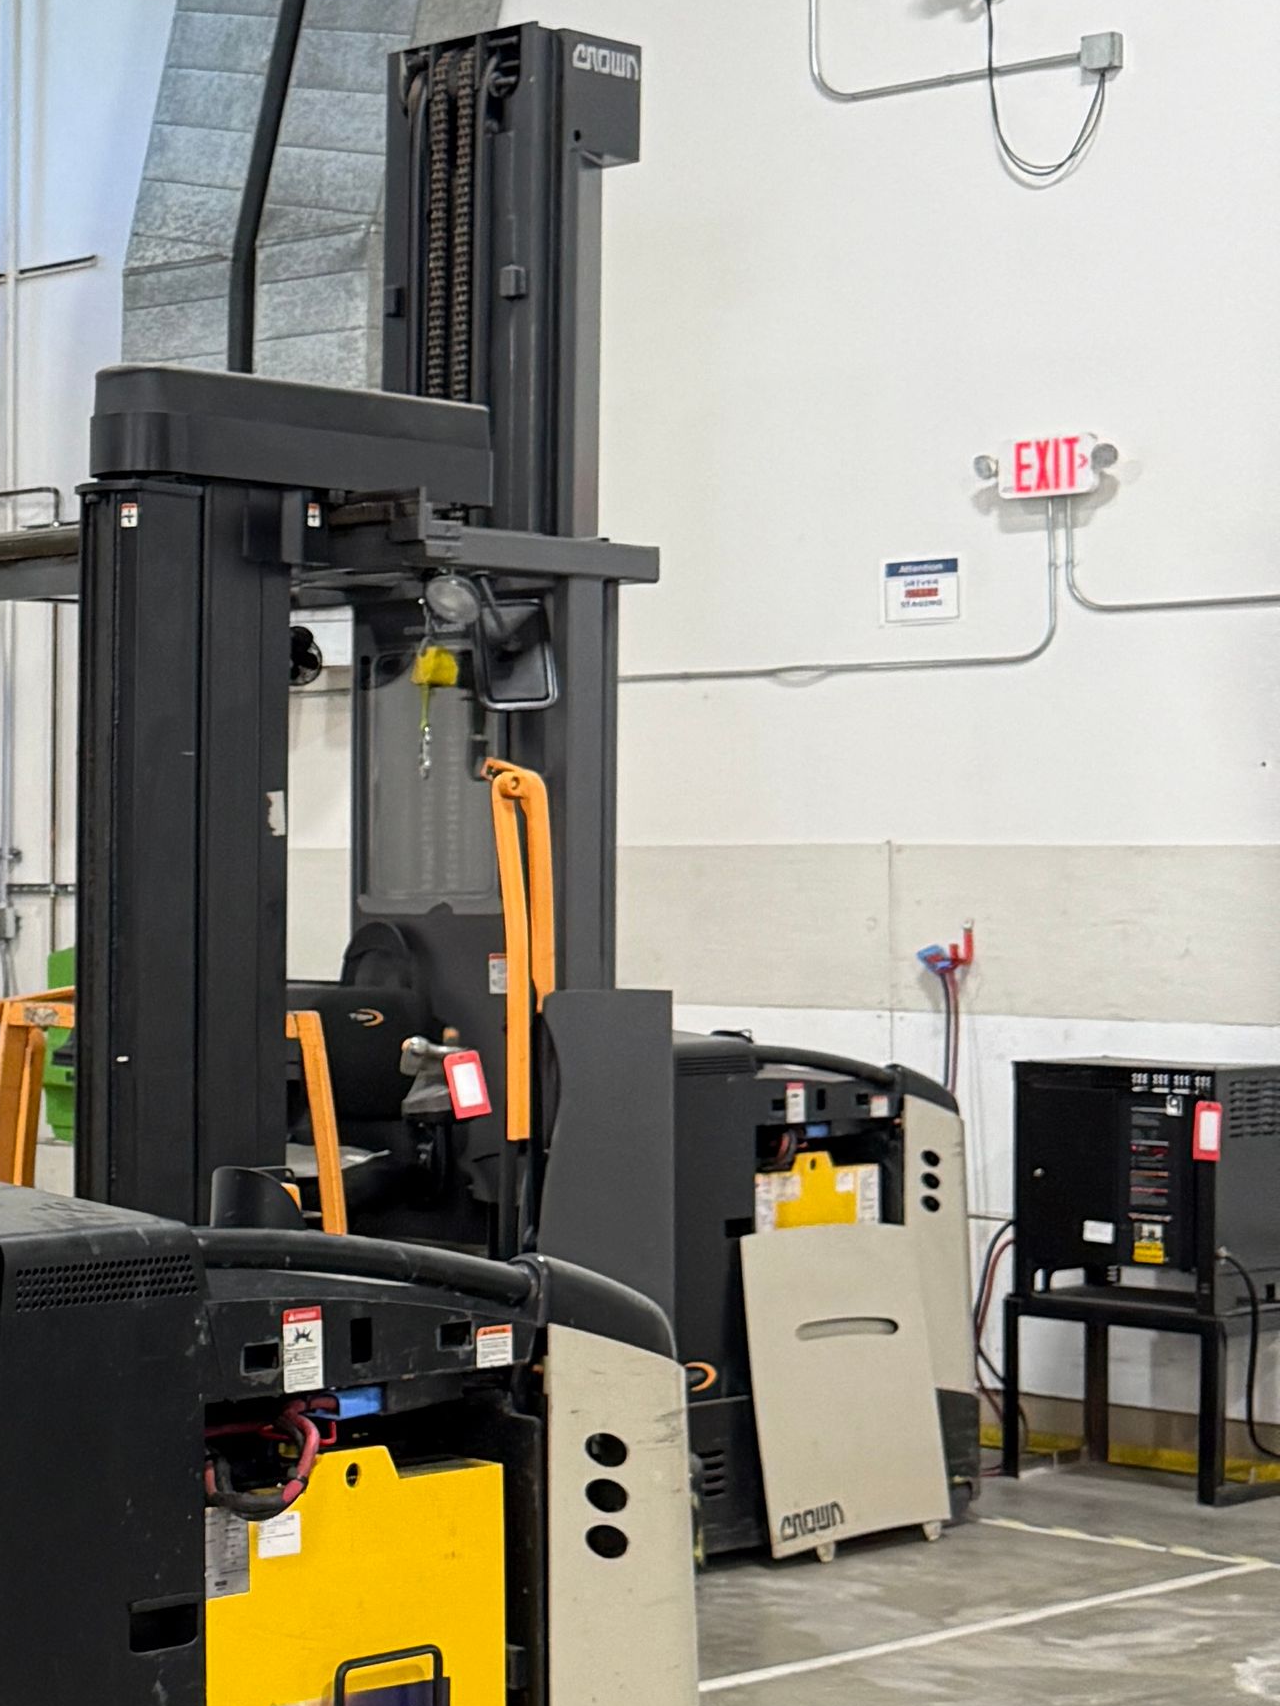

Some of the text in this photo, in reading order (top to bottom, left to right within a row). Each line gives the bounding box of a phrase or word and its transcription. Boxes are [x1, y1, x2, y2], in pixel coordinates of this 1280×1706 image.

[572, 43, 639, 81] CROWN
[1014, 436, 1080, 493] EXIT
[780, 1501, 845, 1542] CROWN
